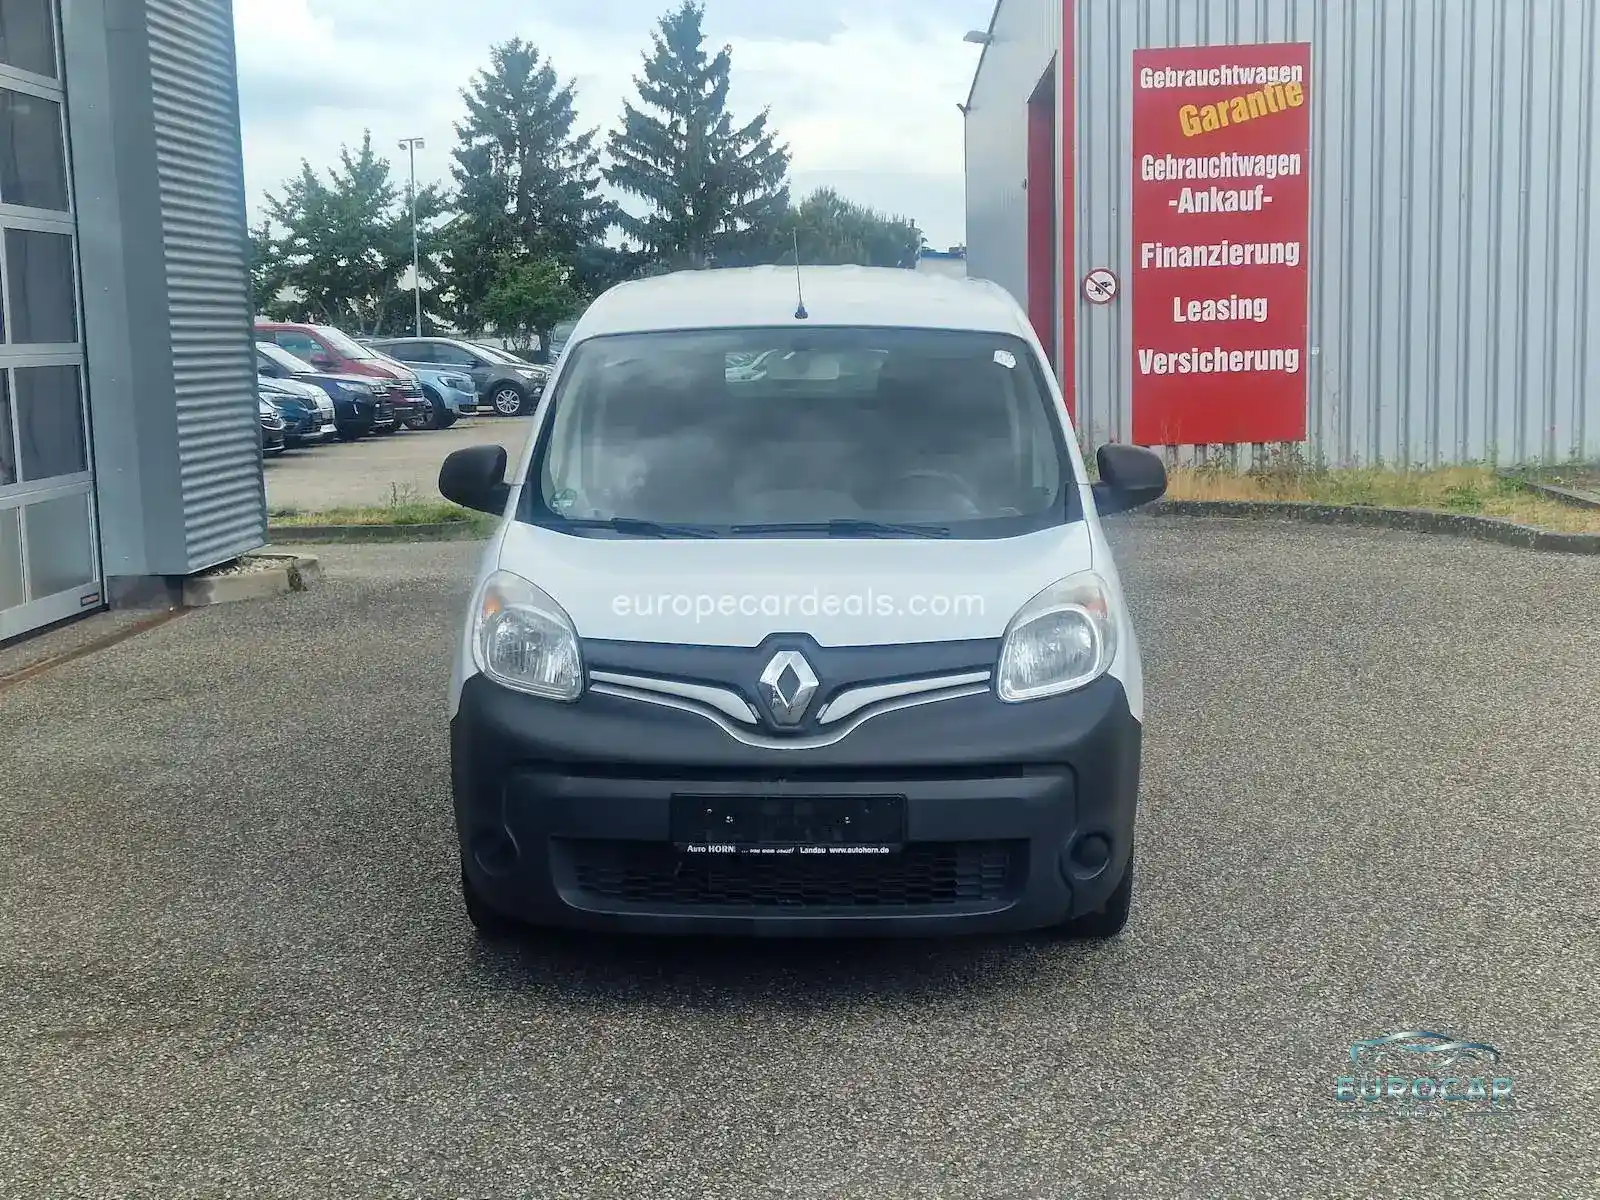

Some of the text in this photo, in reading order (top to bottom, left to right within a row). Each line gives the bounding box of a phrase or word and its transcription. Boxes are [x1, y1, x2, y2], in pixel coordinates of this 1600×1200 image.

[1140, 64, 1303, 89] Gebrauchtwagen
[1178, 81, 1304, 137] Garantie
[1142, 152, 1301, 181] Gebrauchtwagen
[1168, 185, 1273, 213] -Ankauf-
[1141, 240, 1300, 269] Finanzierung
[1173, 294, 1268, 322] Leasing
[1137, 347, 1299, 374] Versicherung
